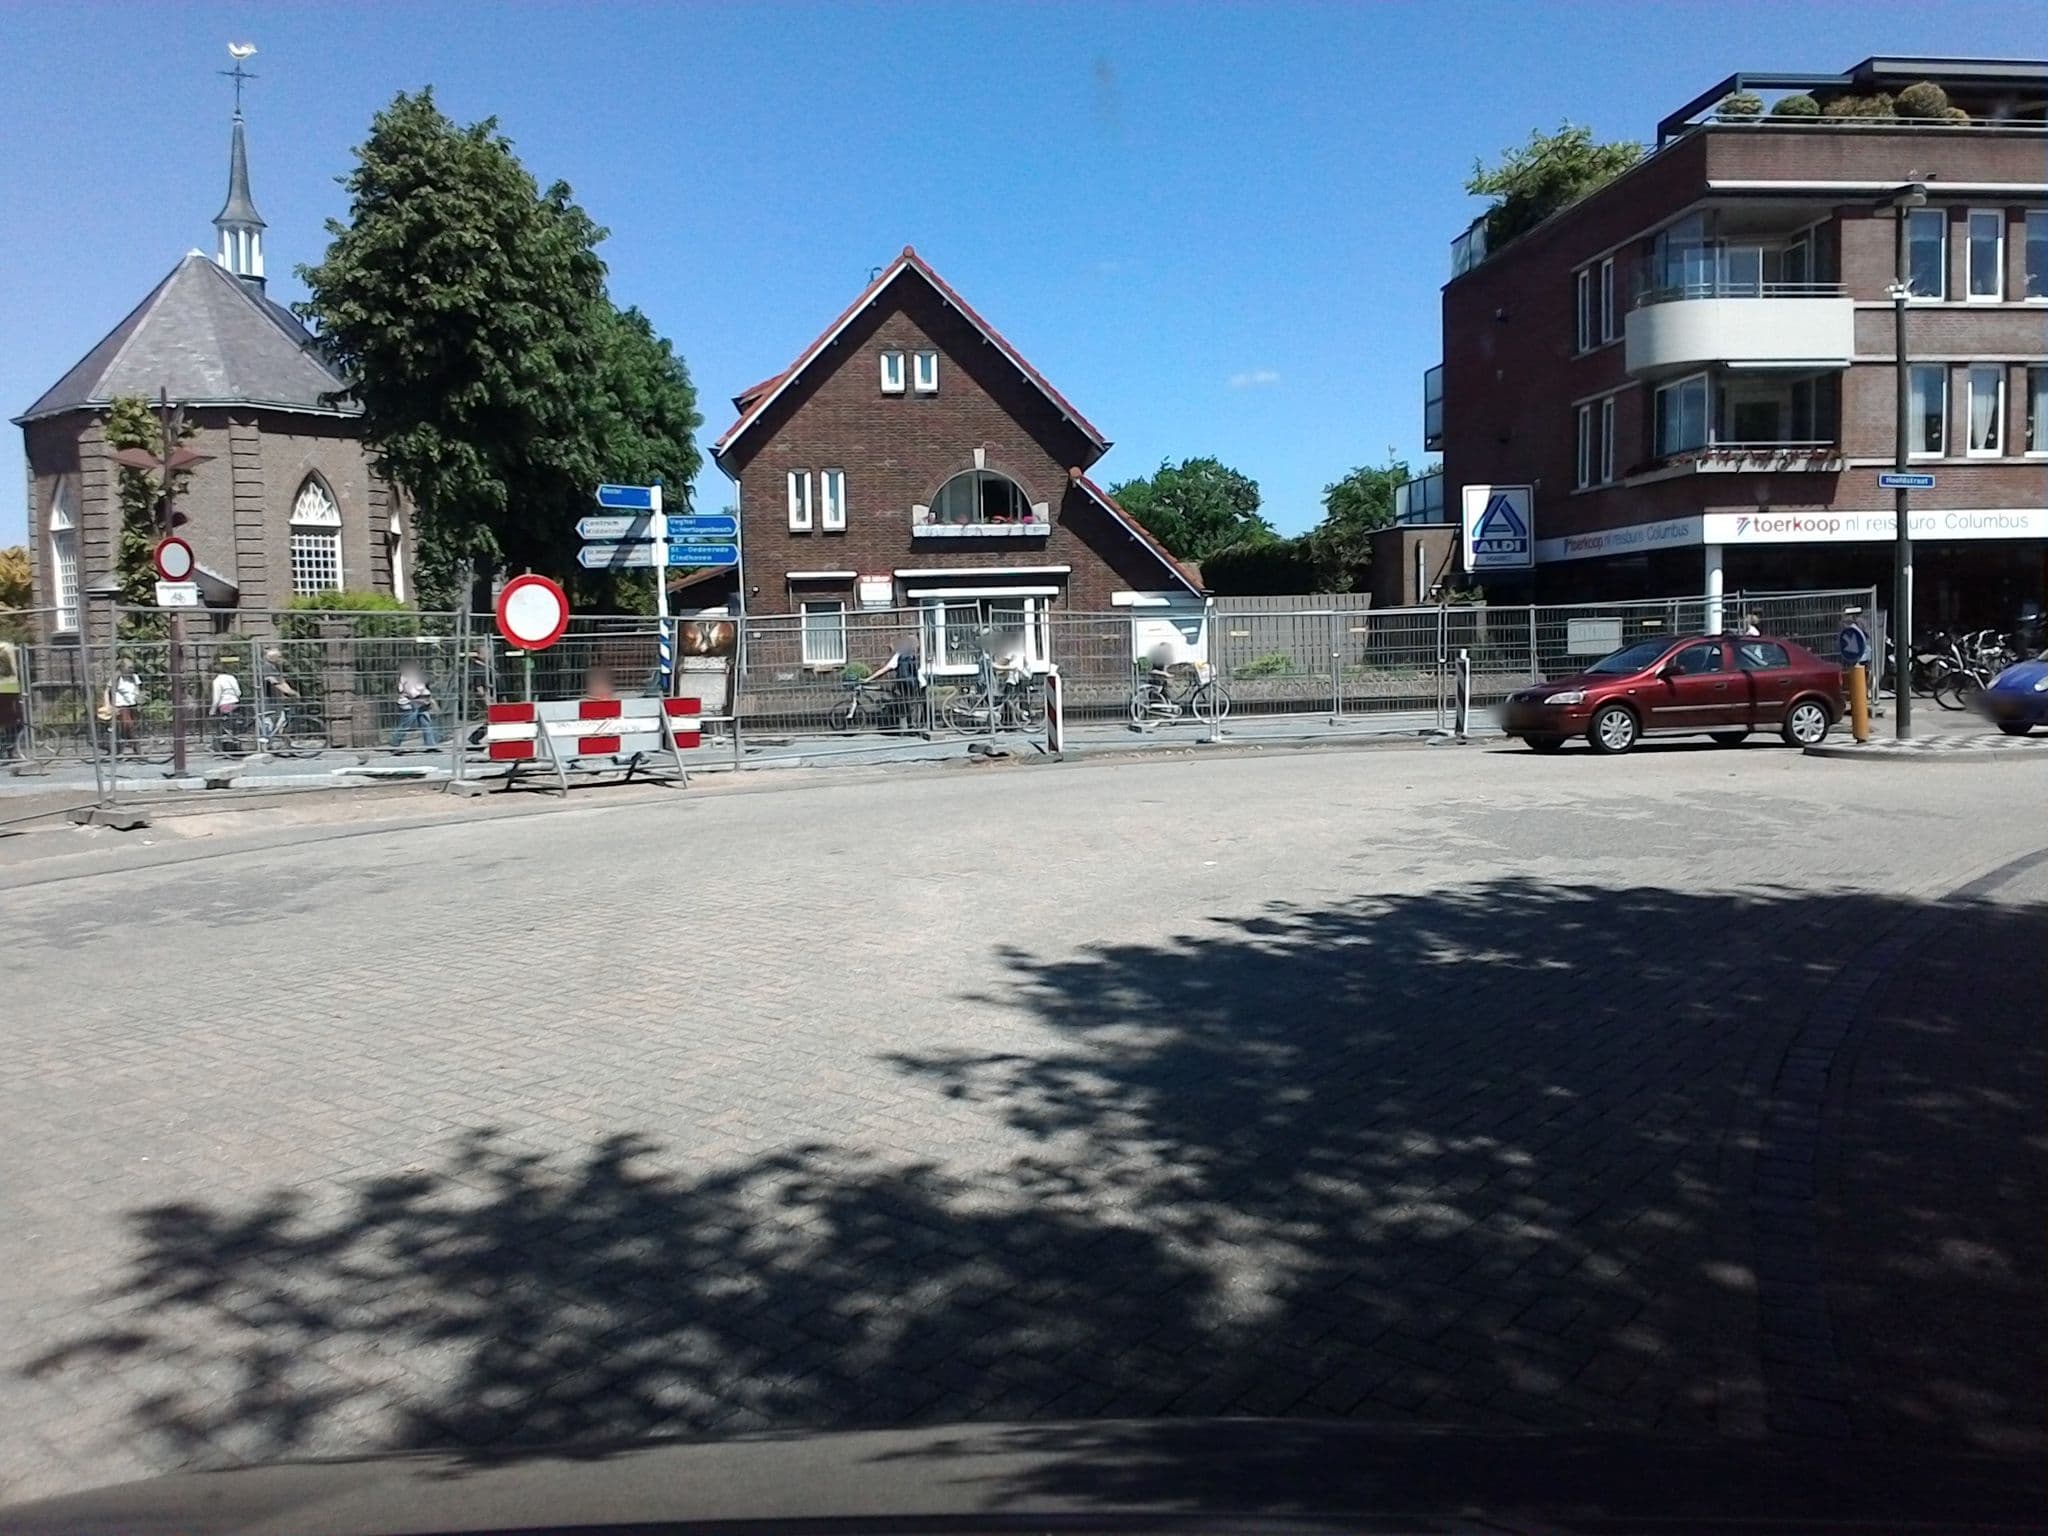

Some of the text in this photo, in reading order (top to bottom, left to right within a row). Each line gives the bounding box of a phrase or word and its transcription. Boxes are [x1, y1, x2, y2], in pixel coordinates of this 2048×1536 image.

[1647, 522, 1689, 541] Columbus
[1754, 516, 1841, 535] toerkoop
[1866, 515, 1936, 531] reisuro
[1945, 512, 2029, 530] Columbus
[1478, 541, 1521, 553] ALDI
